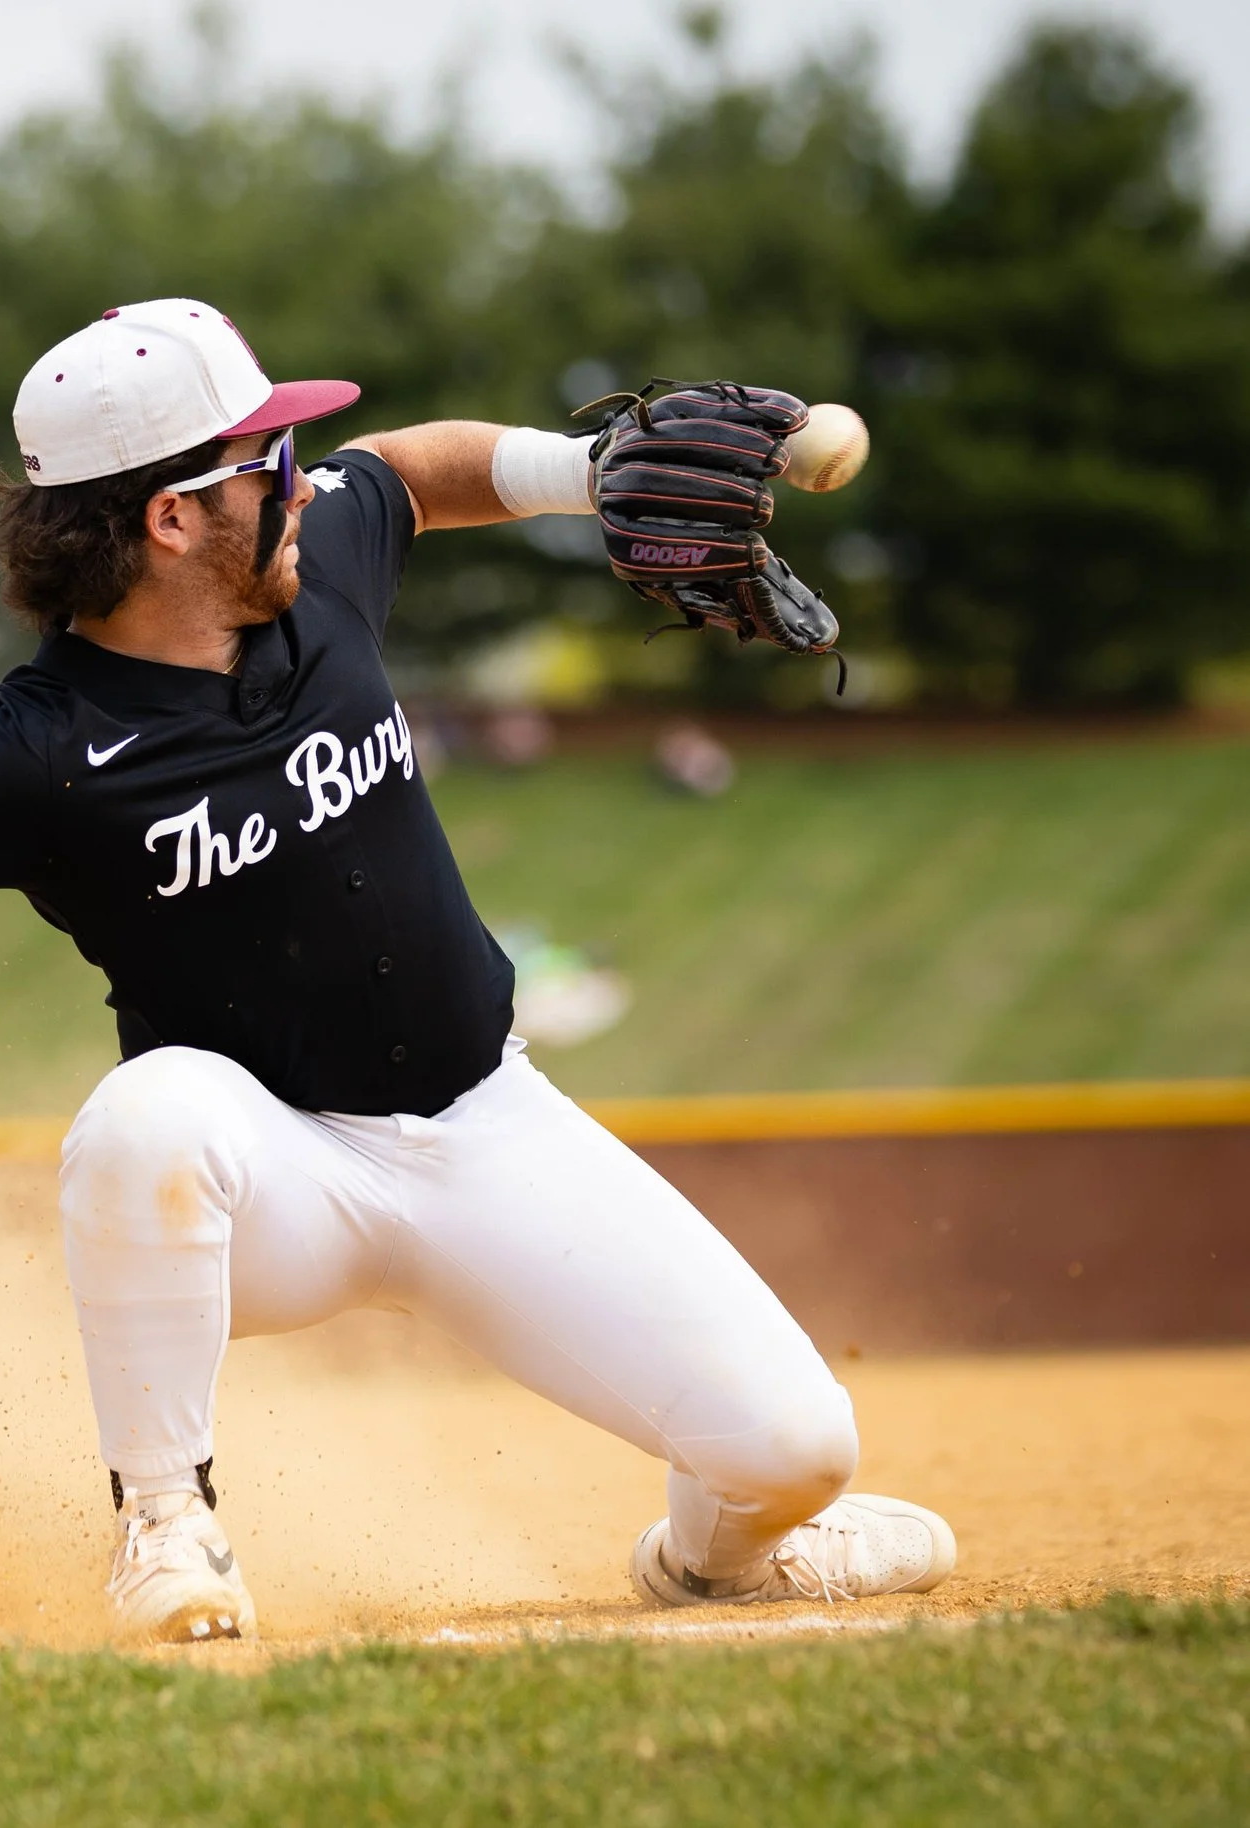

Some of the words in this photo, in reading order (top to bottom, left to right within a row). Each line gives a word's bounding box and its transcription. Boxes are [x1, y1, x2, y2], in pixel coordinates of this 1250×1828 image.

[630, 542, 711, 566] A2000
[145, 796, 277, 898] The
[285, 700, 414, 832] Burg
